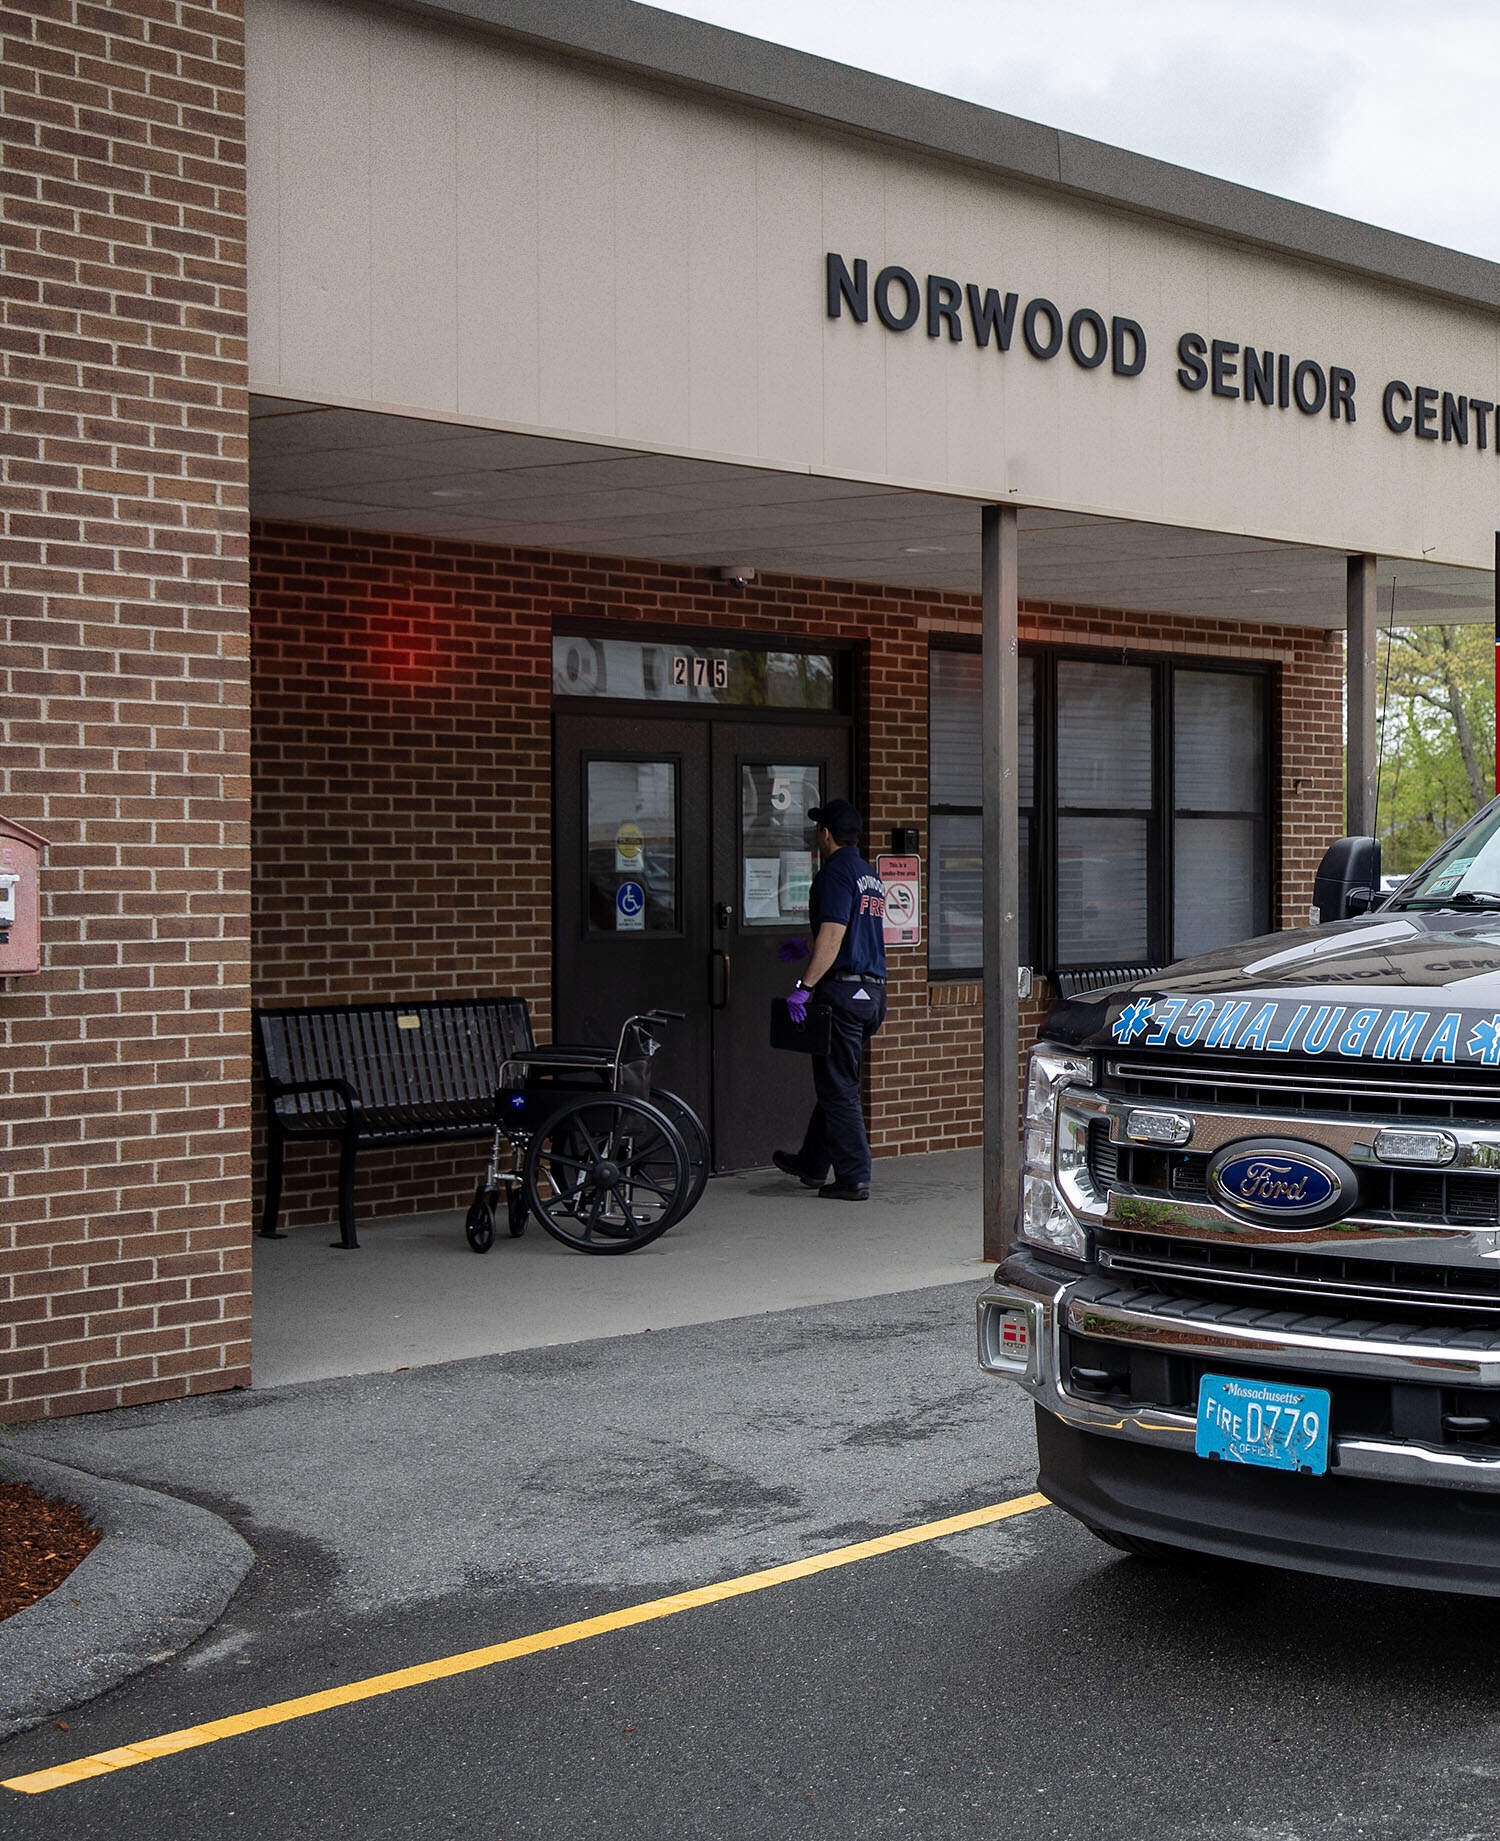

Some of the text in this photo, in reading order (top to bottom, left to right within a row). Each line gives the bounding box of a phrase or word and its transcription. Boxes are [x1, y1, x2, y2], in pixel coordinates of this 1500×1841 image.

[827, 252, 1146, 376] NORWOOD
[1178, 332, 1356, 422] SENIOR
[675, 658, 726, 687] 275
[771, 778, 792, 810] 5
[1241, 1163, 1308, 1200] Ford
[1228, 1383, 1298, 1405] Massachusetts
[1206, 1397, 1319, 1451] FIRE D779
